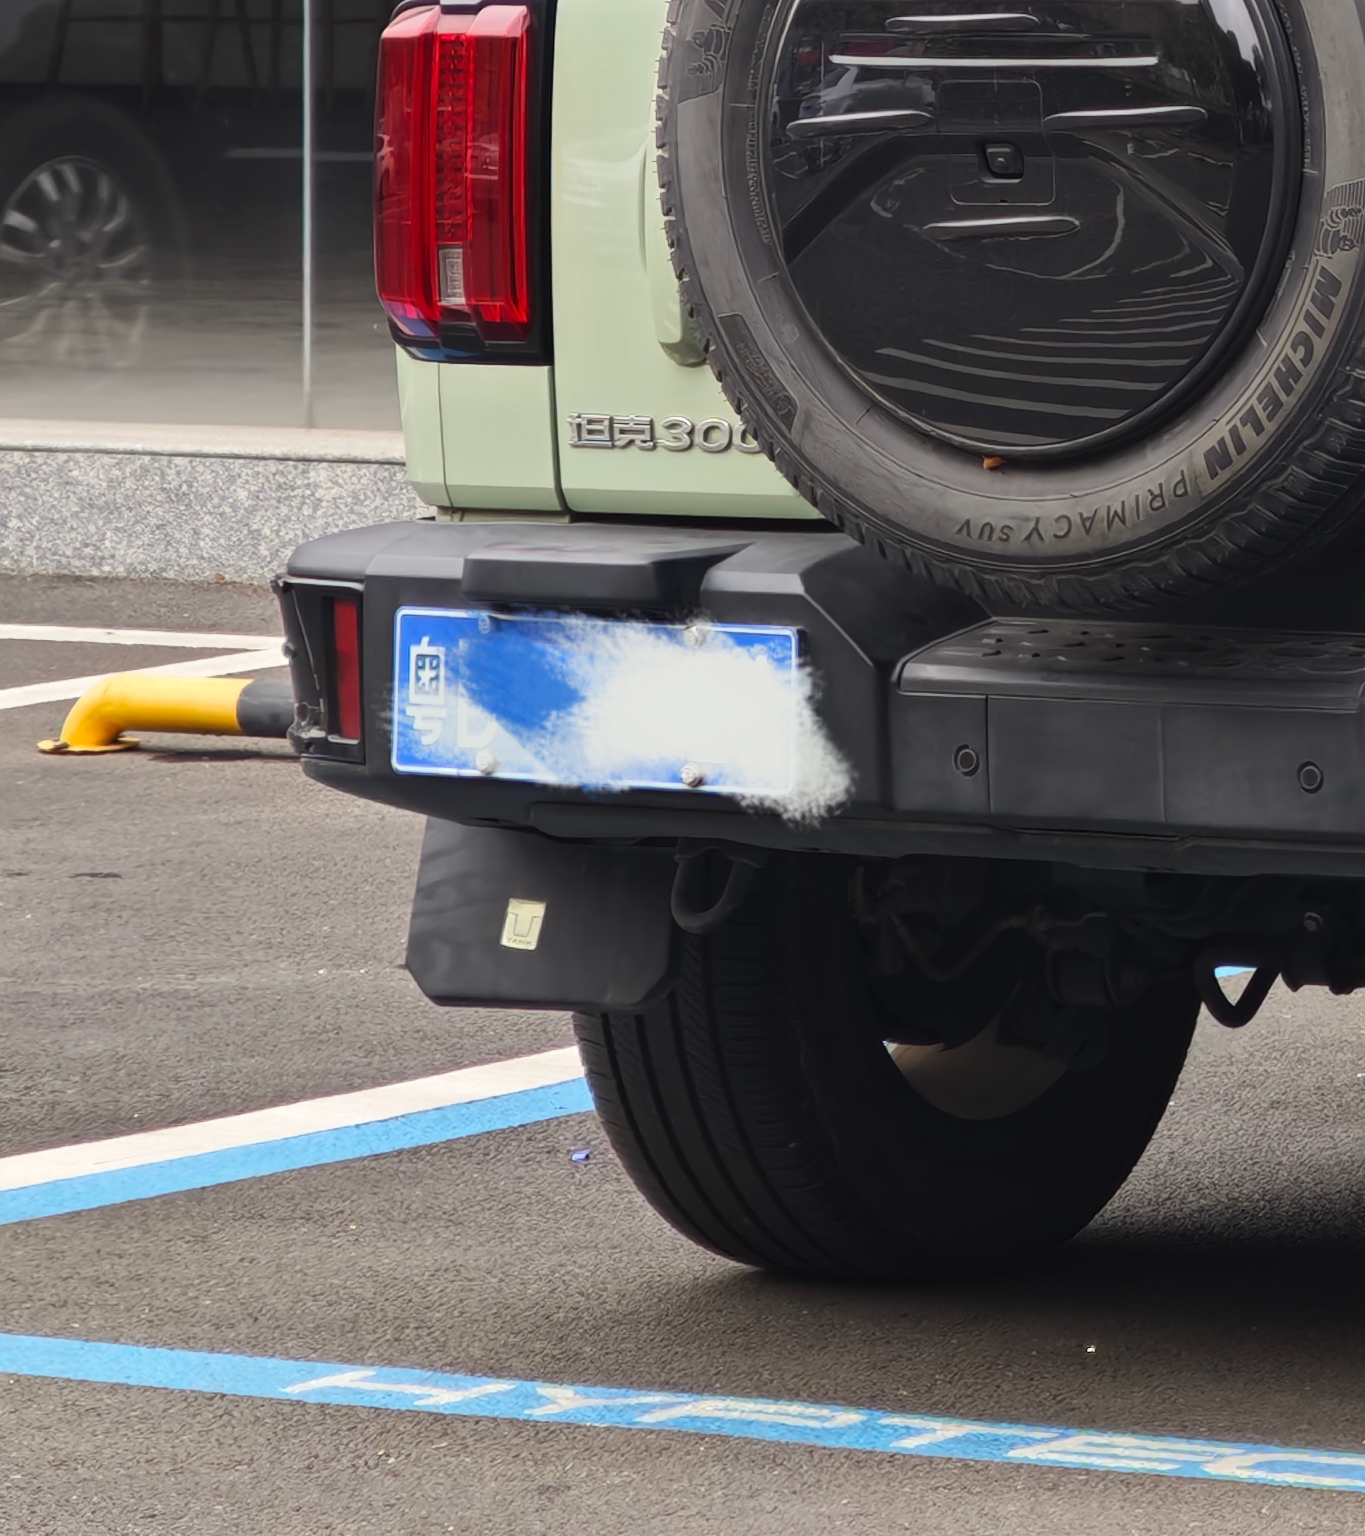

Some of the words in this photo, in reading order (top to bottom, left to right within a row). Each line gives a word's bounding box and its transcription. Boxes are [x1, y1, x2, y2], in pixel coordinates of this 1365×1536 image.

[1201, 266, 1344, 482] MICHELIN
[953, 517, 1014, 544] SUV
[1022, 470, 1190, 545] PRIMACY
